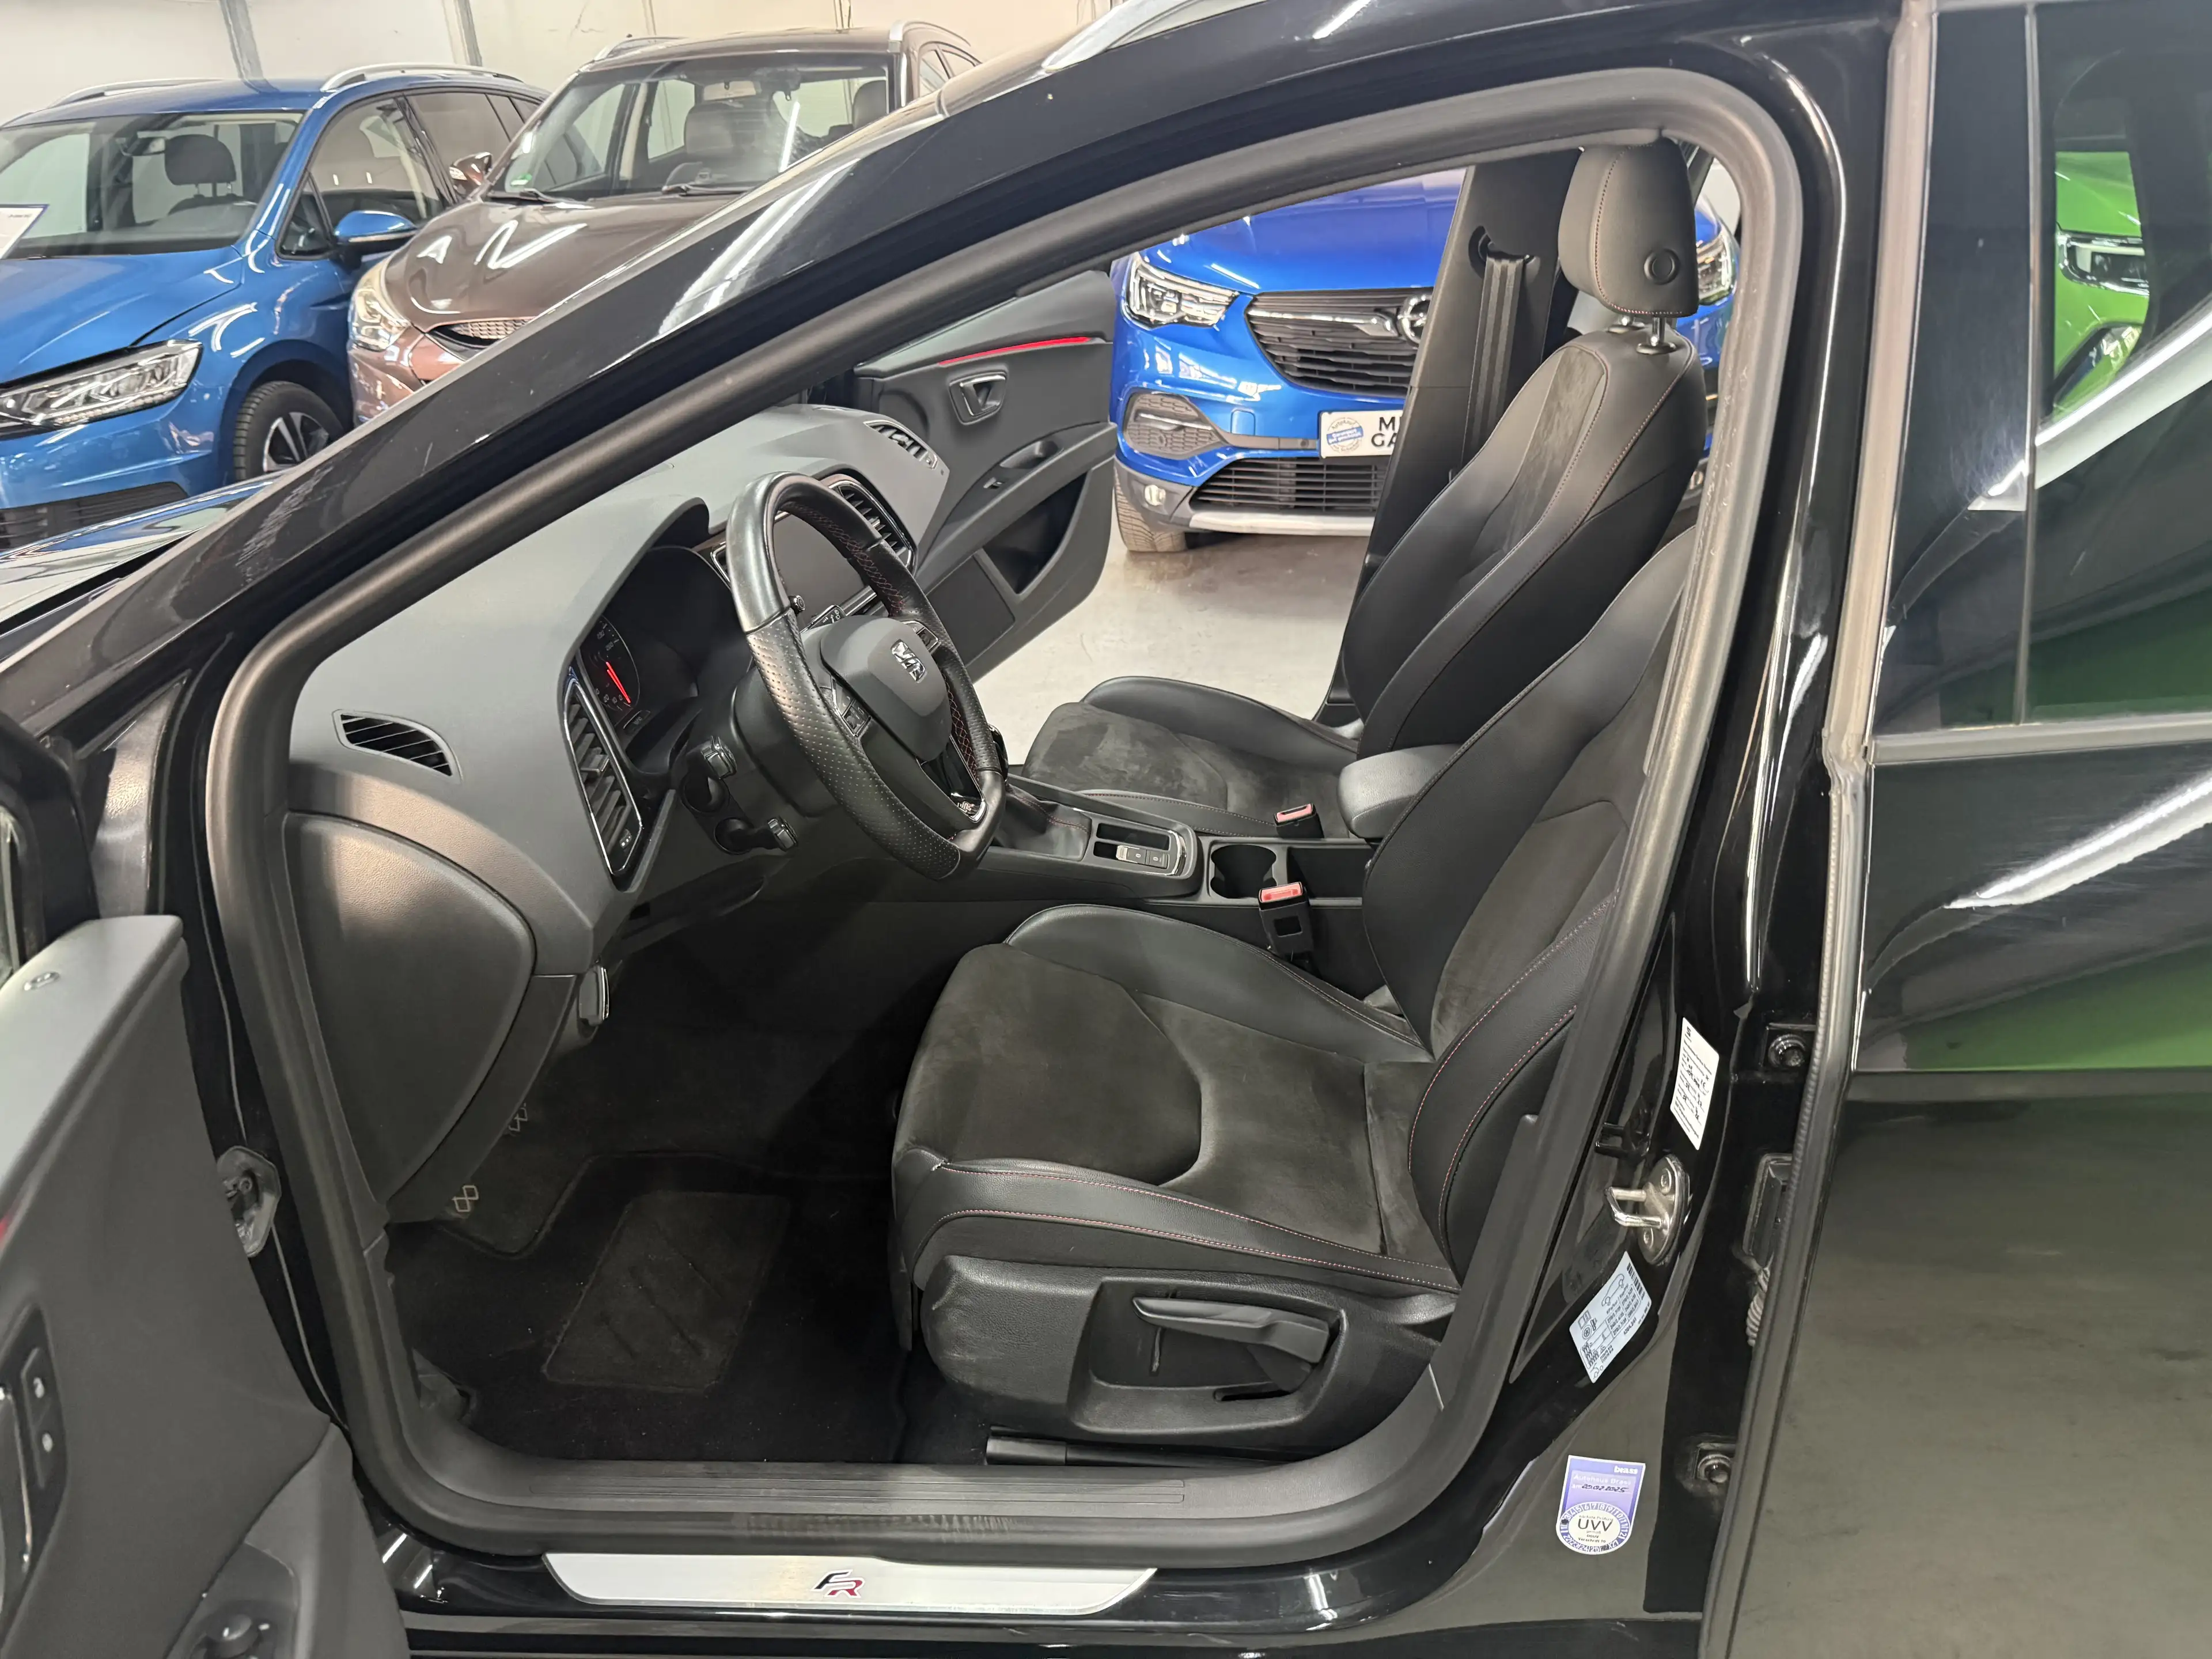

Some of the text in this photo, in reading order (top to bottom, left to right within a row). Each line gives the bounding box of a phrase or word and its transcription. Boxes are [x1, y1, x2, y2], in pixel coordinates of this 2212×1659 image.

[1614, 1465, 1638, 1474] brass
[1573, 1474, 1608, 1483] Autohaus
[1578, 1518, 1613, 1532] UVV
[812, 1570, 863, 1597] FR
